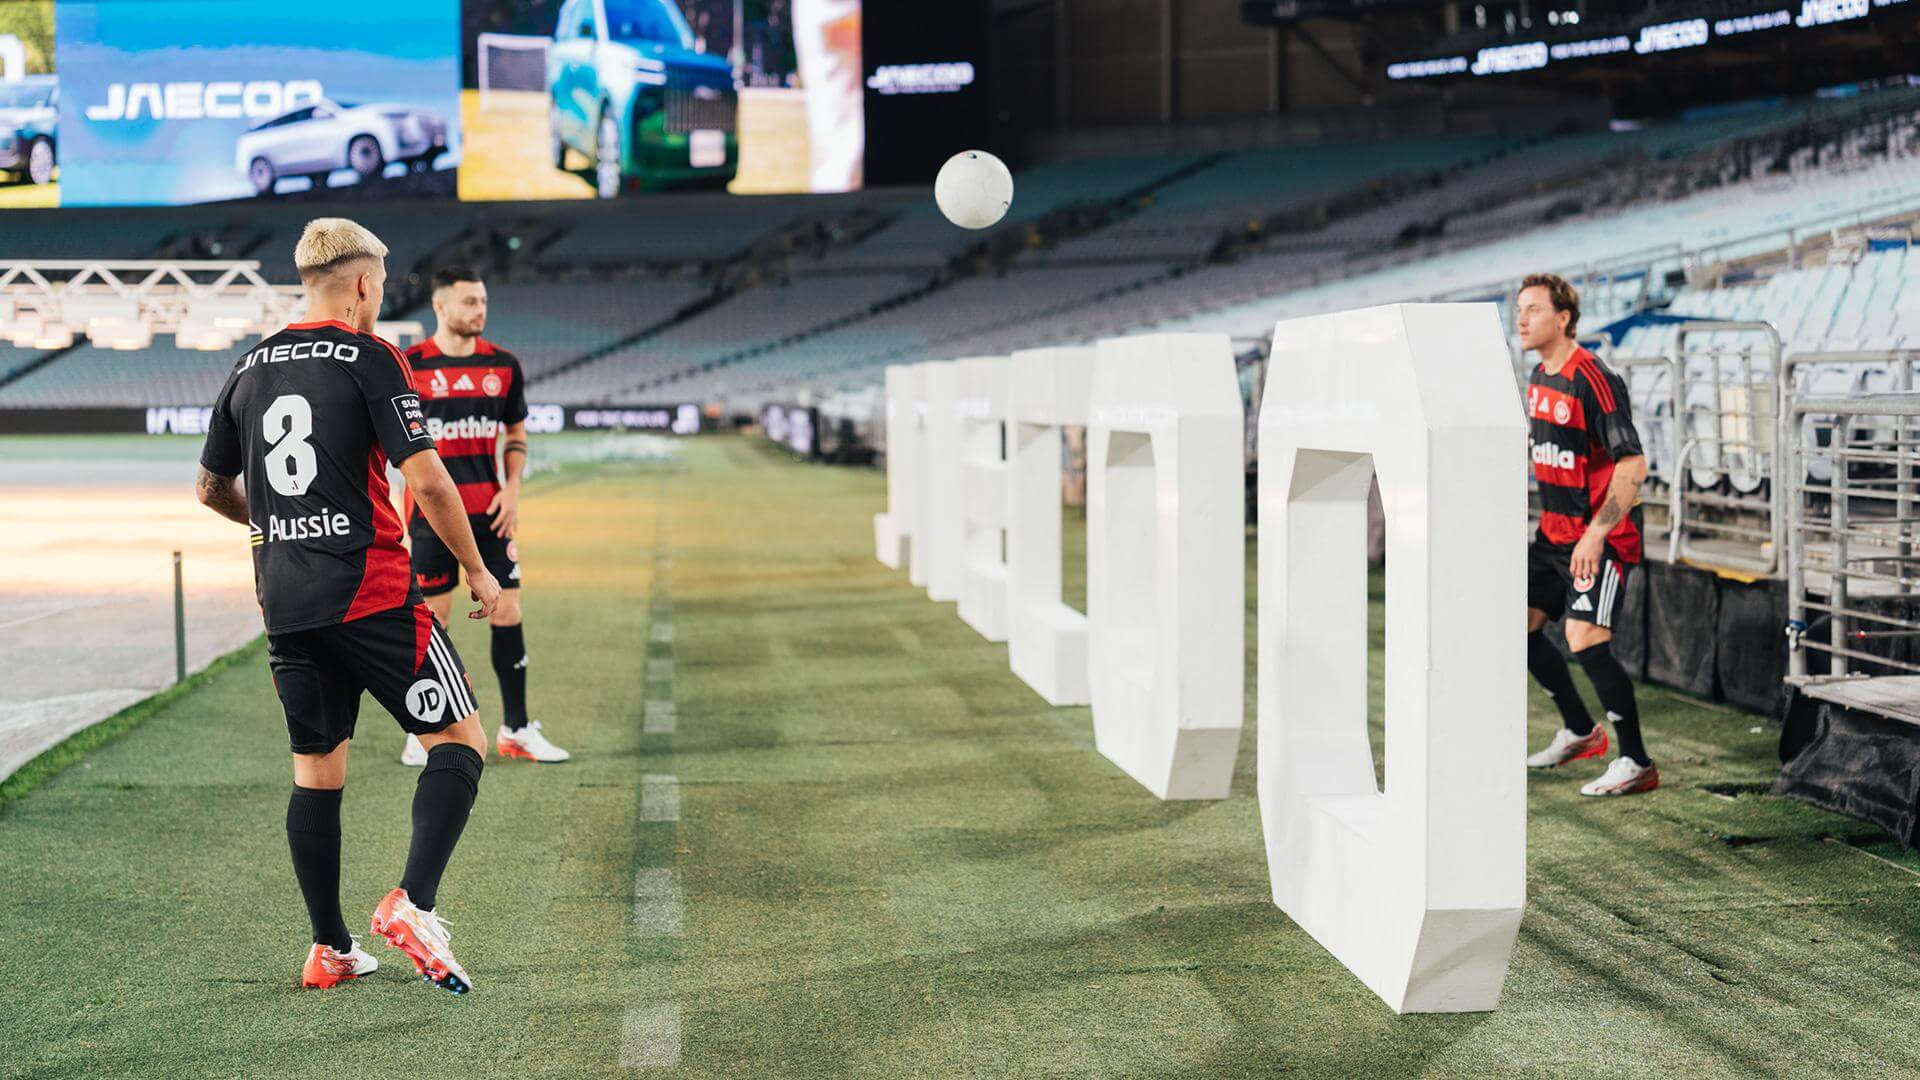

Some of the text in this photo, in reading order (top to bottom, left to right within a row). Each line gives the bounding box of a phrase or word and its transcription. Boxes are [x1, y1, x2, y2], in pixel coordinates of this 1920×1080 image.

[237, 341, 360, 375] JAECOO
[262, 394, 318, 497] 8
[269, 508, 350, 543] Aussie
[417, 687, 440, 716] JD
